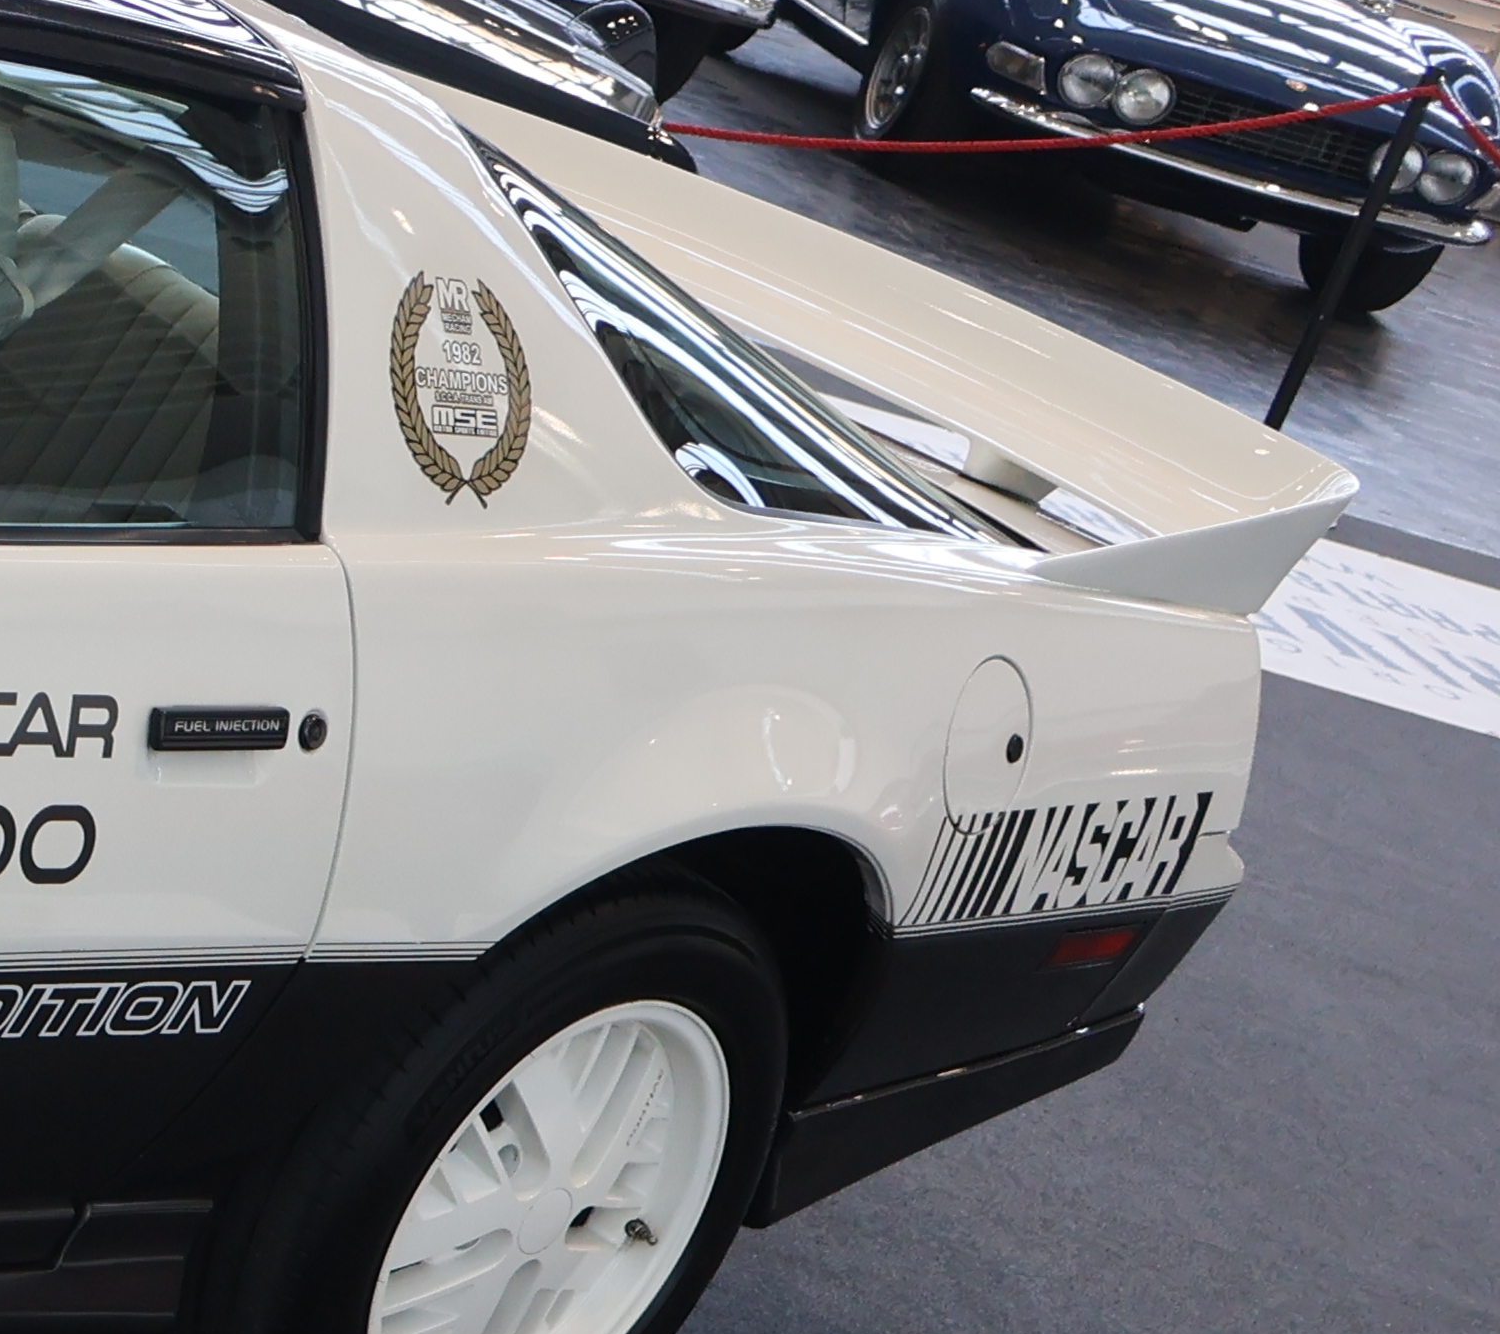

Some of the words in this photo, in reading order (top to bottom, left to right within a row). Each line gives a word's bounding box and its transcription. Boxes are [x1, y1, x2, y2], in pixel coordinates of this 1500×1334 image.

[435, 277, 470, 313] MR
[441, 312, 473, 326] MECHAM
[444, 322, 472, 335] RACING
[442, 339, 482, 365] 1982
[415, 365, 509, 395] CHAMPIONS
[174, 720, 211, 733] FUEL
[215, 719, 280, 732] INJECTION
[1003, 791, 1214, 913] NASCAR
